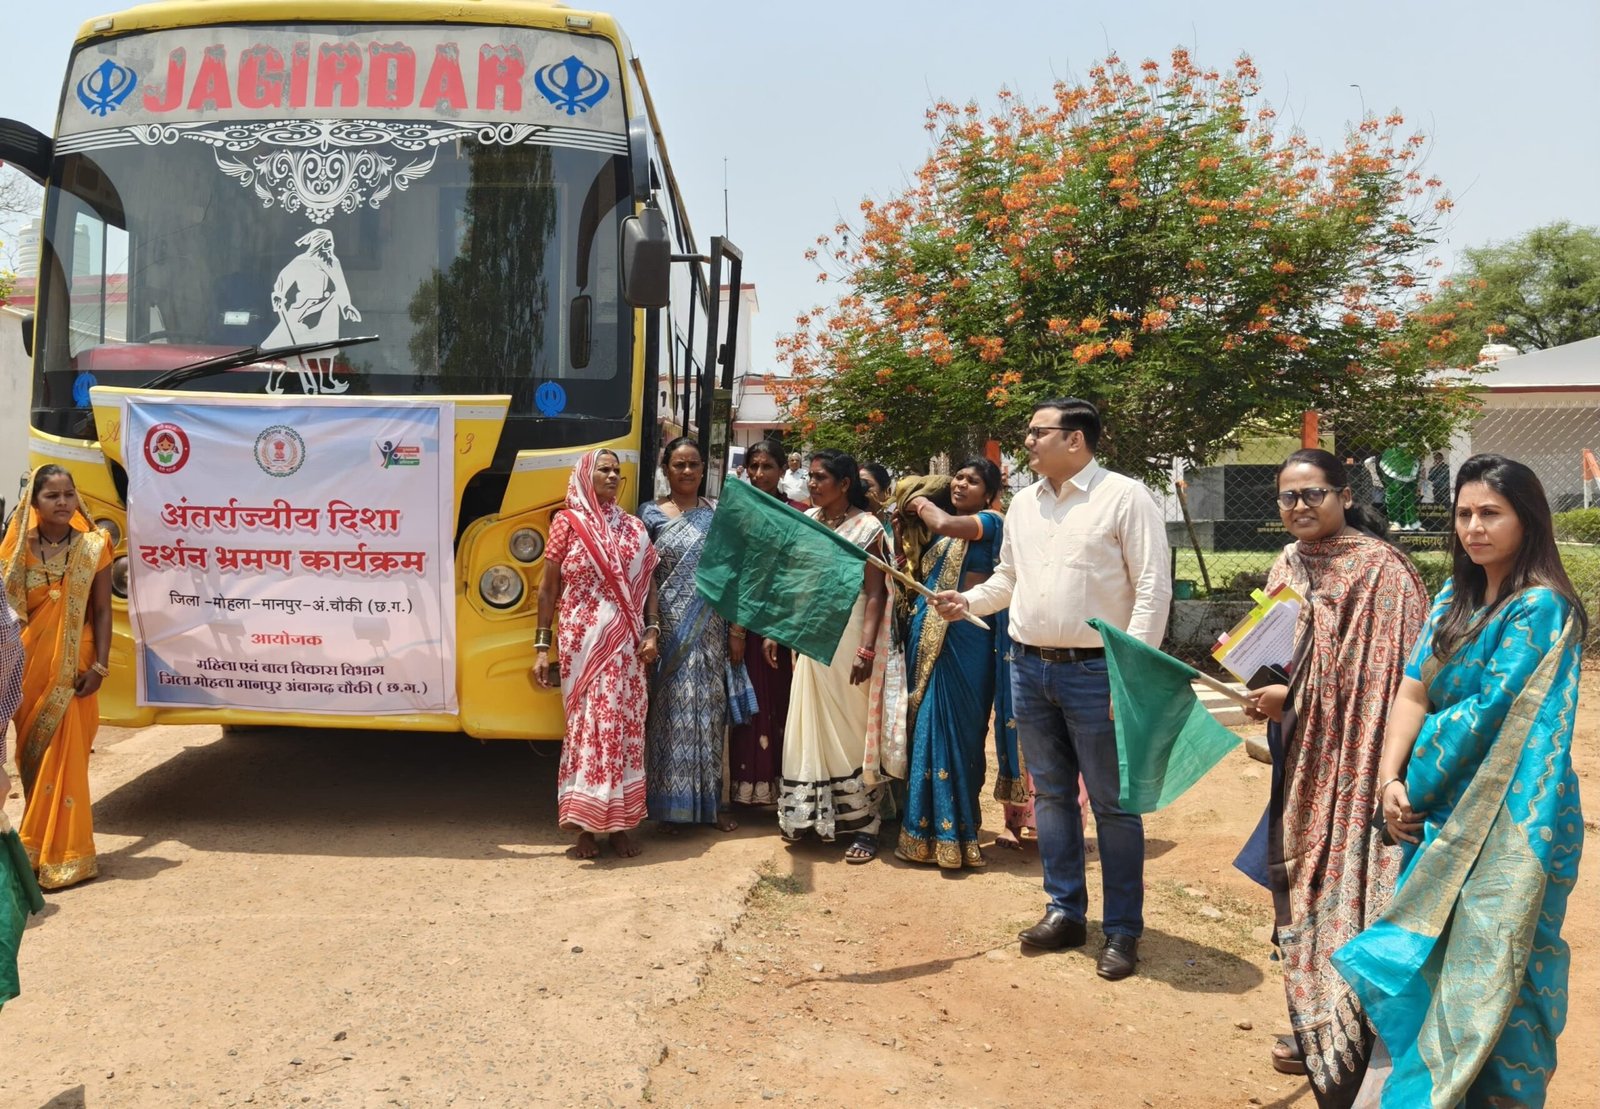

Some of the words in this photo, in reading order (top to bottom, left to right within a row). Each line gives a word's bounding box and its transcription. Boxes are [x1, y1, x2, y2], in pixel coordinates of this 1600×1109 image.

[143, 42, 524, 112] JAGIRDAR
[162, 497, 320, 530] अंतर्राज्यीय
[328, 499, 401, 532] दिशा
[139, 538, 208, 568] दर्शन
[215, 545, 292, 570] भ्रमण
[299, 542, 426, 572] कार्यक्रम
[169, 589, 200, 607] जिला
[250, 630, 323, 646] आयोजक
[196, 656, 238, 672] महिला
[239, 659, 260, 673] एवं
[261, 663, 289, 674] बाल
[291, 660, 339, 676] विकास
[340, 662, 385, 676] विभाग
[159, 671, 191, 686] जिला
[193, 673, 235, 689] मोहला
[236, 678, 283, 695] मानपुर
[336, 680, 373, 695] चौकी
